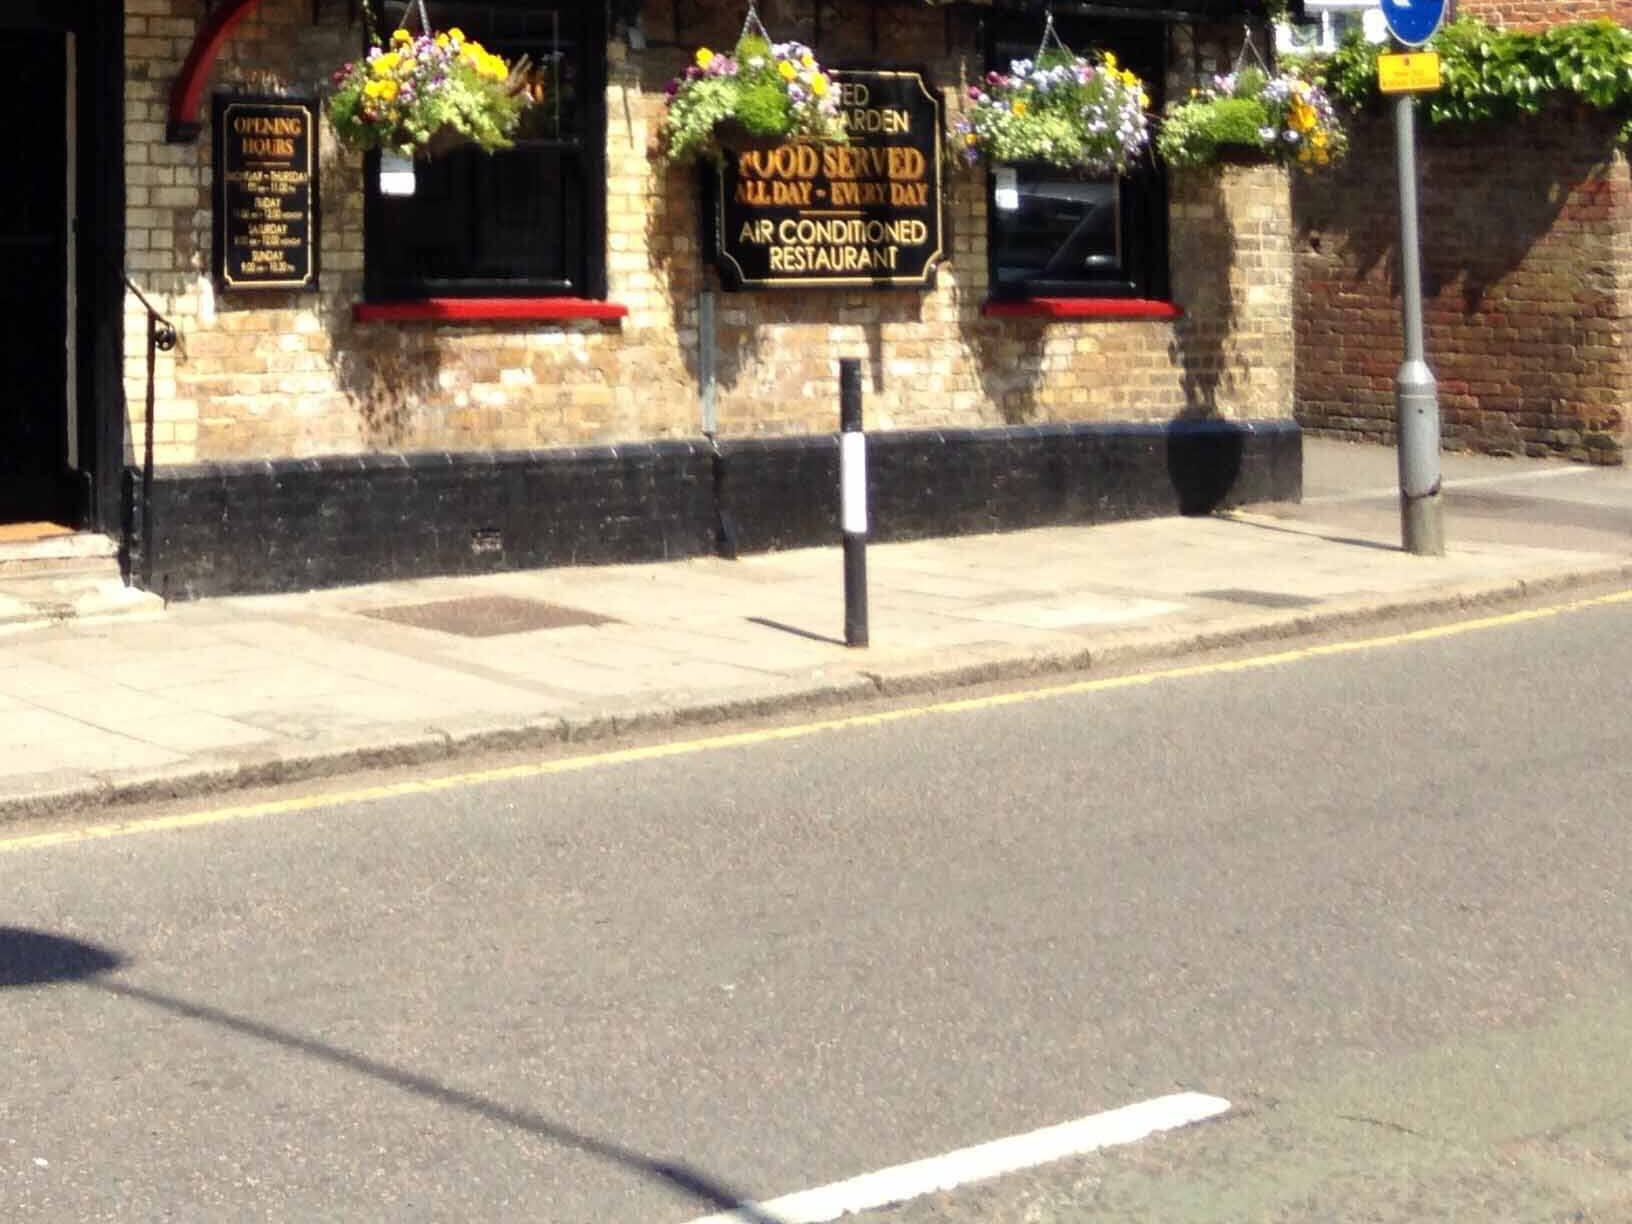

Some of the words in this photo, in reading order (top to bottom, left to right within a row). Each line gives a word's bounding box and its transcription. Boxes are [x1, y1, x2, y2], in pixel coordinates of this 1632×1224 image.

[234, 117, 302, 136] OPENING
[242, 138, 294, 156] HOURS
[823, 145, 925, 179] SERVED
[735, 180, 770, 206] ALL
[773, 180, 812, 206] DAY
[831, 181, 886, 206] EVERY
[887, 181, 929, 207] DAY
[739, 219, 773, 244] AIR
[779, 219, 927, 245] CONDITIONED
[770, 246, 898, 271] RESTAURANT
